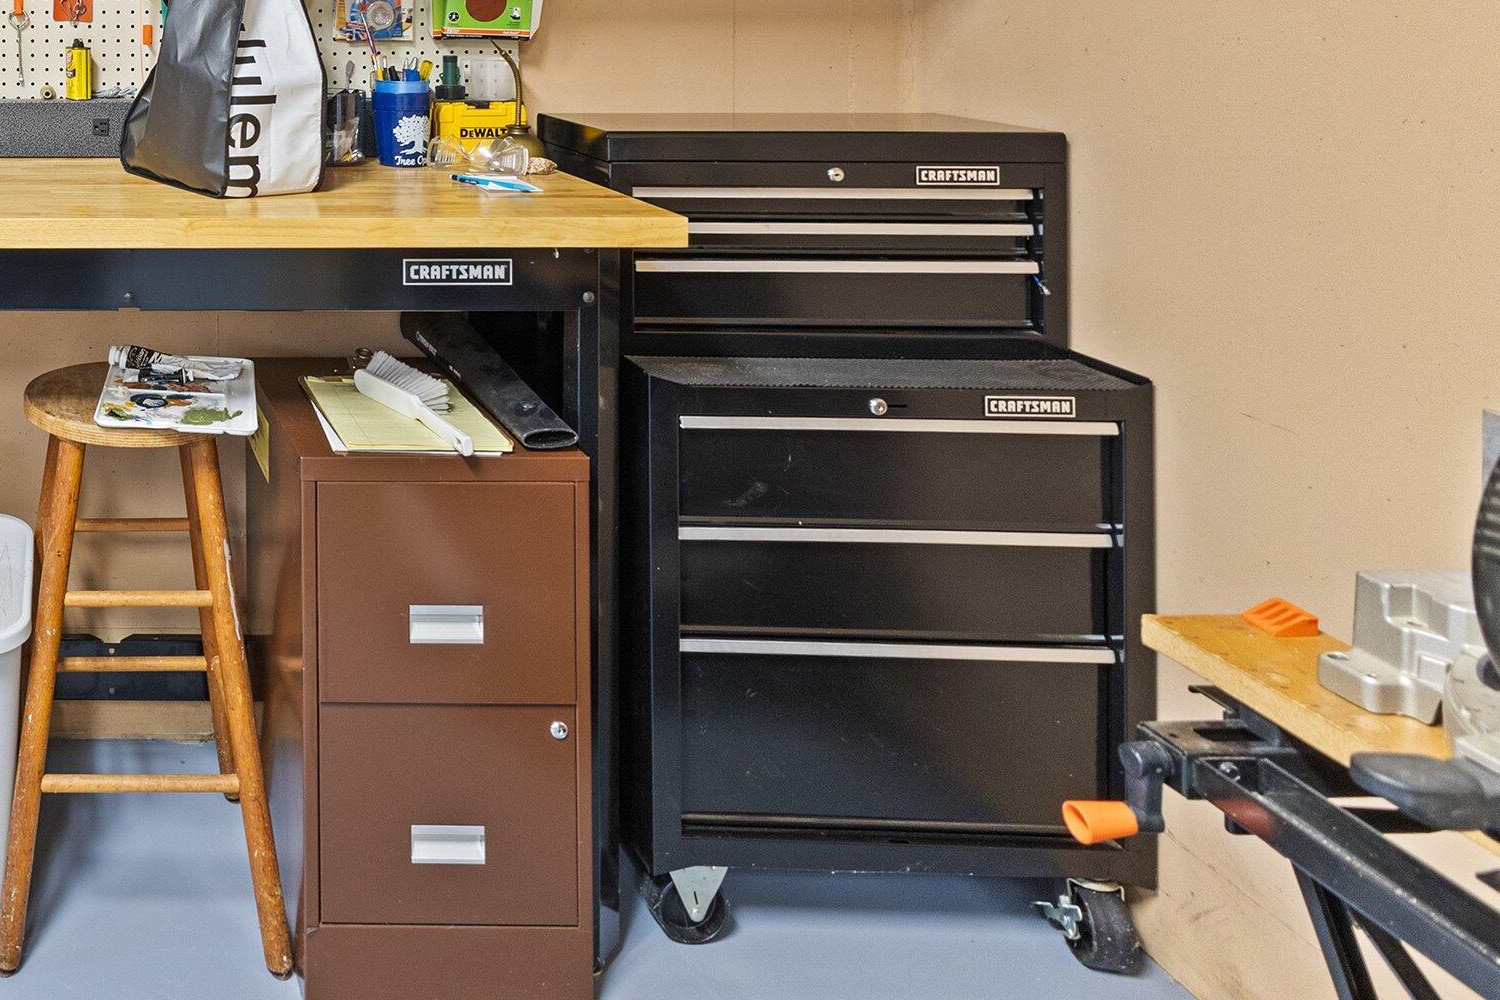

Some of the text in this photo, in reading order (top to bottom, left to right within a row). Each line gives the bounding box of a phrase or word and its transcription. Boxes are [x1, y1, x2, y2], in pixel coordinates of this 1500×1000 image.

[394, 155, 417, 166] Tree
[920, 169, 996, 182] CRAFTSMAN
[409, 264, 507, 280] CRAFTSMAN
[989, 400, 1071, 414] CRAFTSMAN
